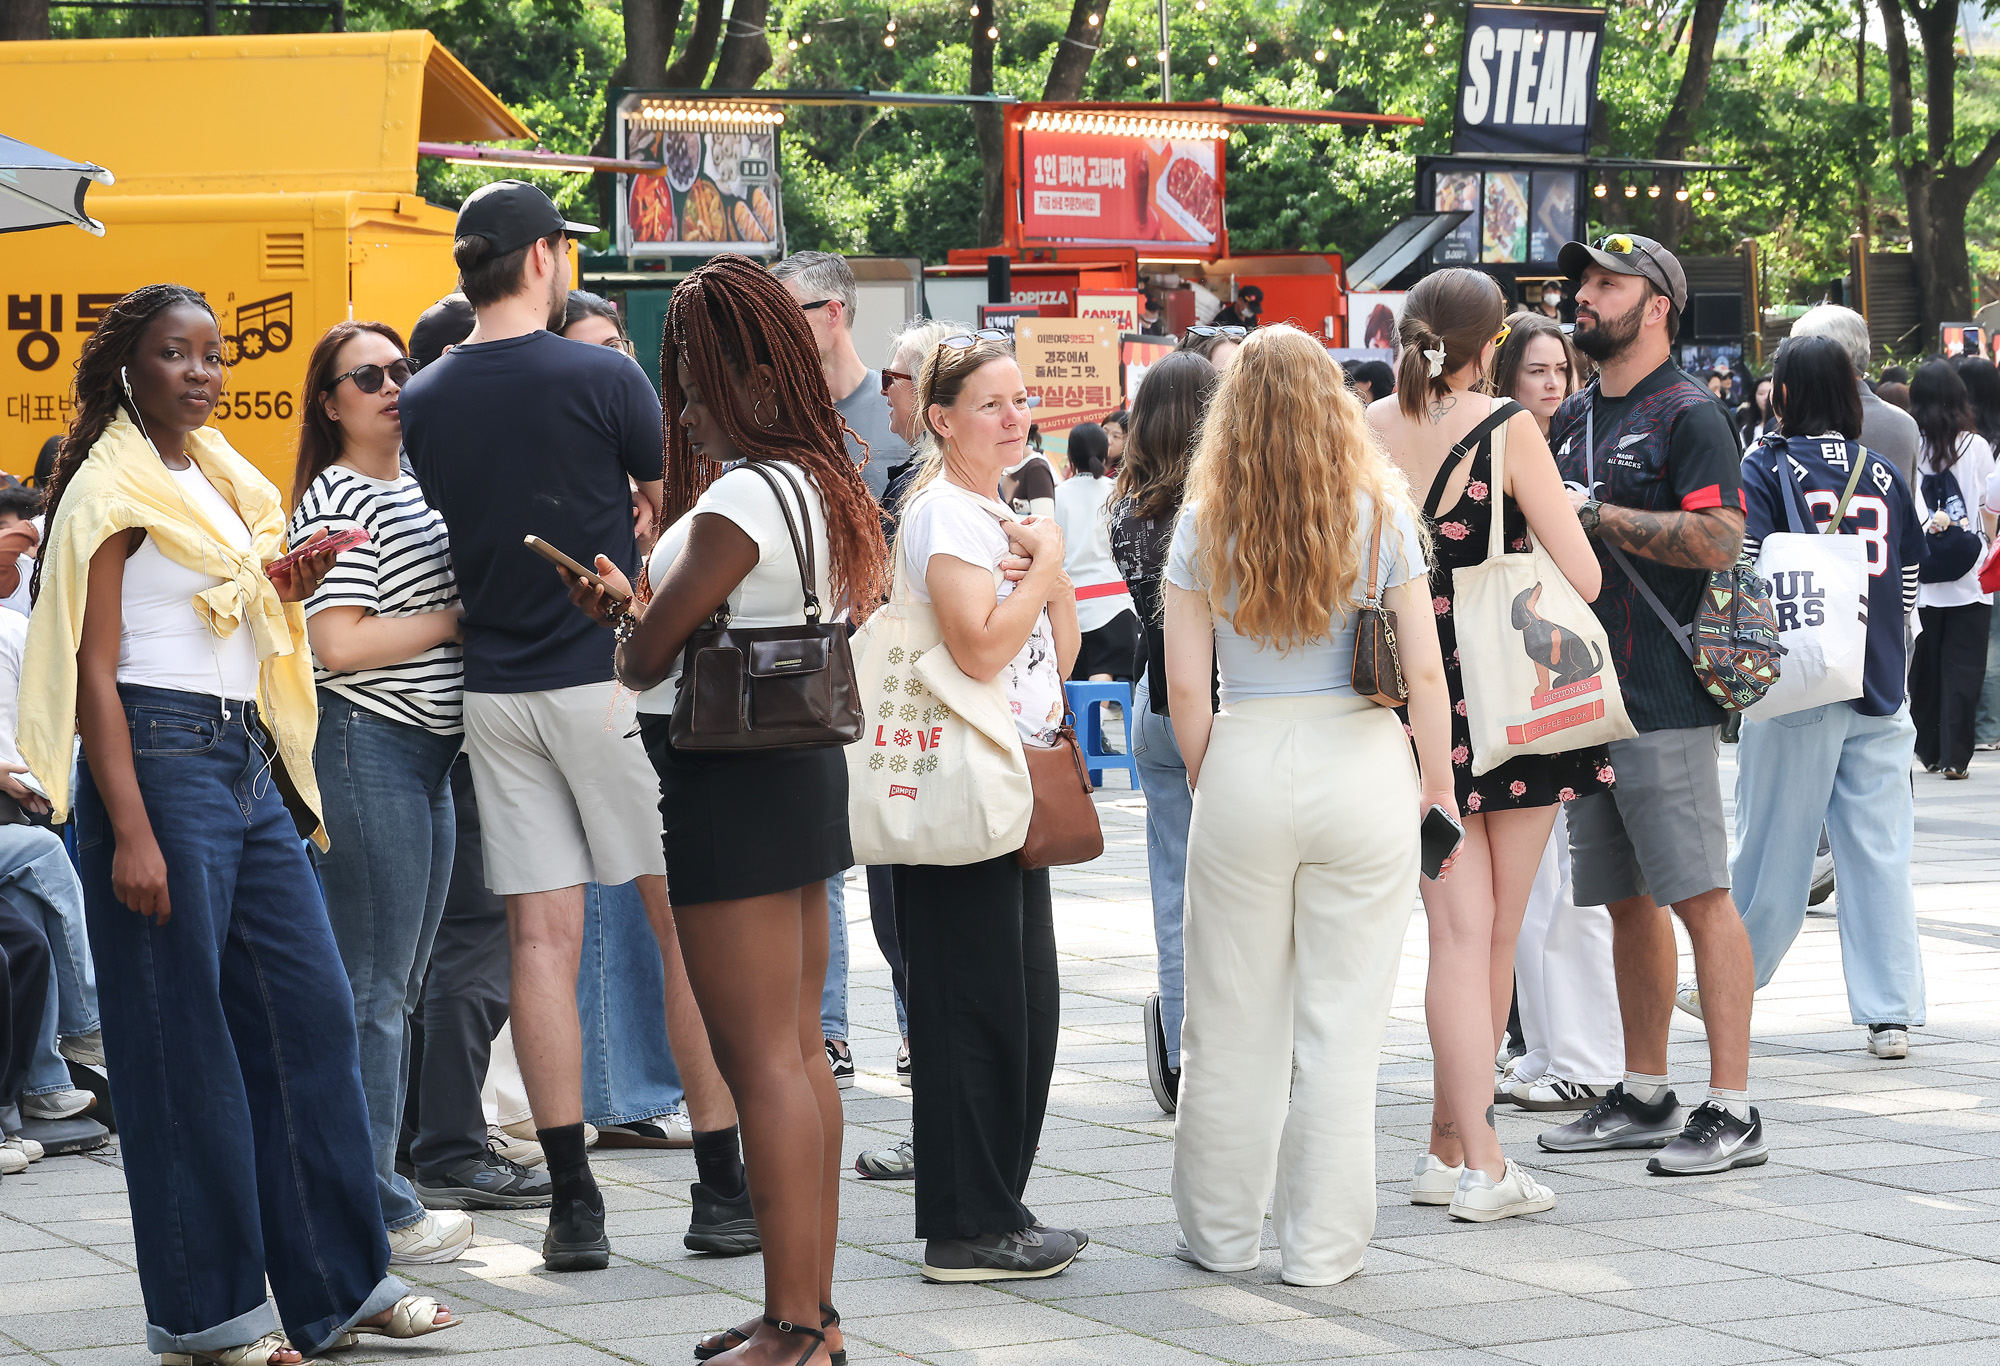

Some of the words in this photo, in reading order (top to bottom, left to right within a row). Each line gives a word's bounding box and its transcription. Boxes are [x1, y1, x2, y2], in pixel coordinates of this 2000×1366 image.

[1463, 25, 1597, 125] STEAK
[1034, 154, 1057, 186] 1인
[1059, 155, 1086, 187] 피자
[1087, 157, 1126, 189] 고피자
[1045, 351, 1089, 363] 경주에서
[1035, 366, 1068, 378] 줄서는
[1071, 366, 1082, 378] 그
[214, 391, 293, 420] 5556
[1038, 419, 1066, 429] BEAUTY
[1067, 417, 1082, 425] FOX
[1616, 452, 1635, 460] MAORI
[1618, 460, 1641, 469] BLACKS
[1765, 571, 1825, 601] UL
[1543, 682, 1592, 703] DICTIONARY
[1531, 719, 1562, 735] COFFEE
[1564, 711, 1588, 723] BOOK
[891, 786, 916, 798] CAMPER
